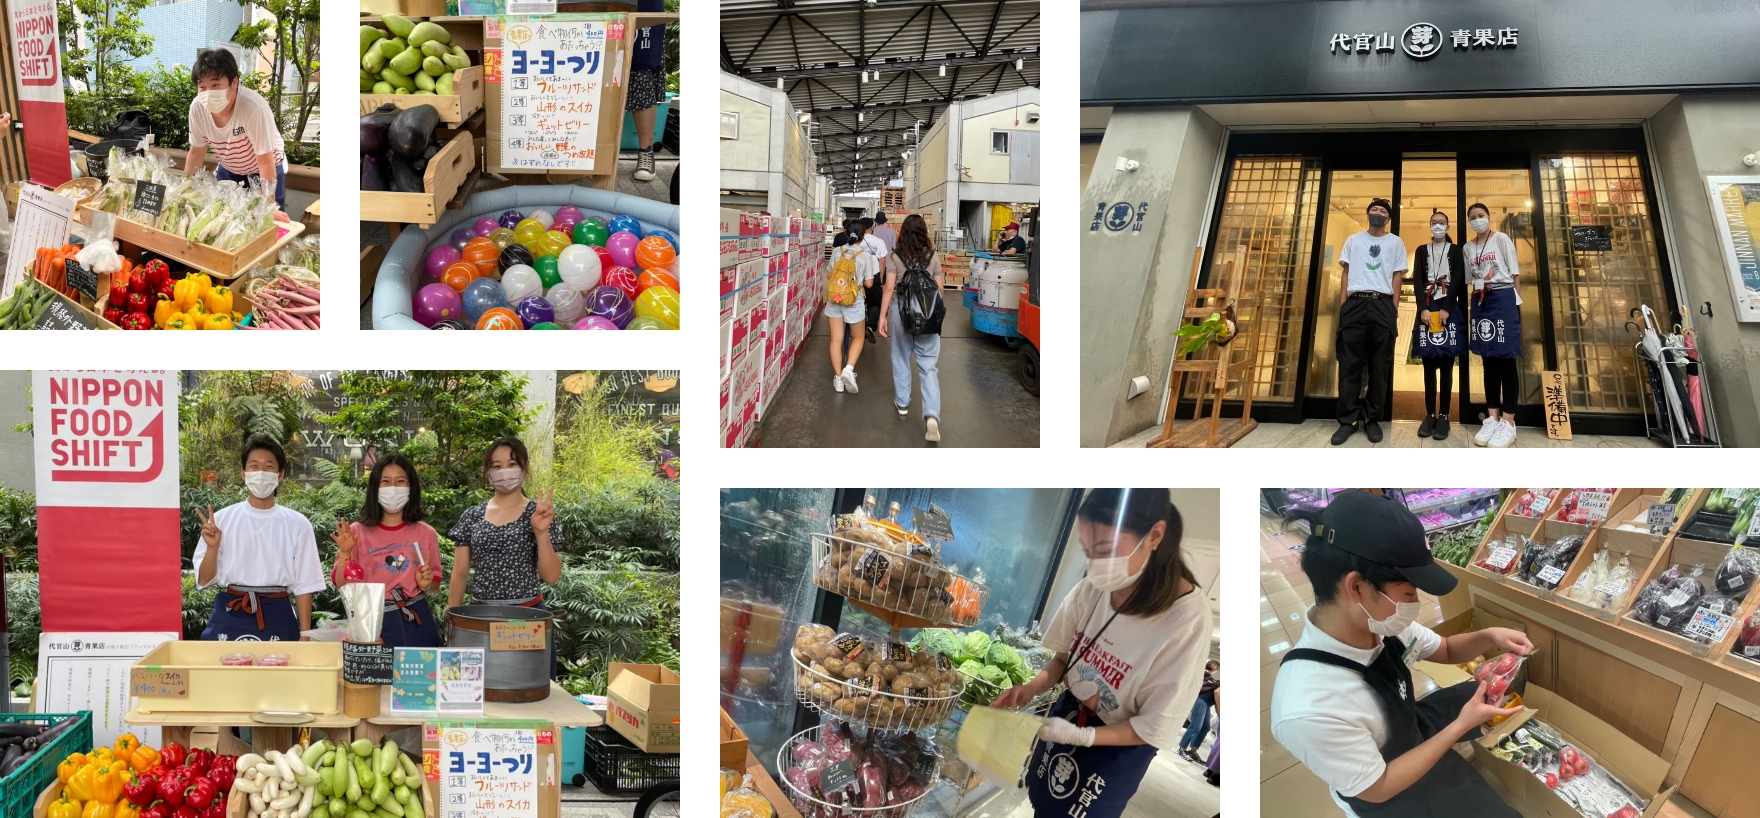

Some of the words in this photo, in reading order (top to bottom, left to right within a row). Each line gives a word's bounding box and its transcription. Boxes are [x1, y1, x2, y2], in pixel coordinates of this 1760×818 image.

[16, 15, 54, 39] NIPPON
[18, 38, 44, 58] FOOD
[1330, 32, 1395, 52] 代官山
[1450, 28, 1519, 48] 青果店
[20, 58, 48, 76] SHIFT
[512, 50, 600, 74] ヨーヨーつり
[537, 82, 597, 94] フルーツサンド
[537, 120, 590, 130] ギュットゼリー
[1132, 202, 1148, 231] 代官山
[1721, 190, 1747, 227] MARKE
[1731, 229, 1757, 269] JINNAN
[1497, 319, 1505, 343] 代官山
[50, 377, 163, 407] NIPPON
[320, 371, 333, 391] OF
[51, 408, 132, 436] FOOD
[51, 439, 142, 467] SHIFT
[1083, 637, 1133, 673] BREAKFAST
[1077, 646, 1125, 690] SUMMER
[135, 683, 155, 693] ¥400
[449, 751, 533, 774] ヨーヨーつり
[475, 781, 532, 792] フルーツサンド
[1068, 773, 1106, 818] 代官山
